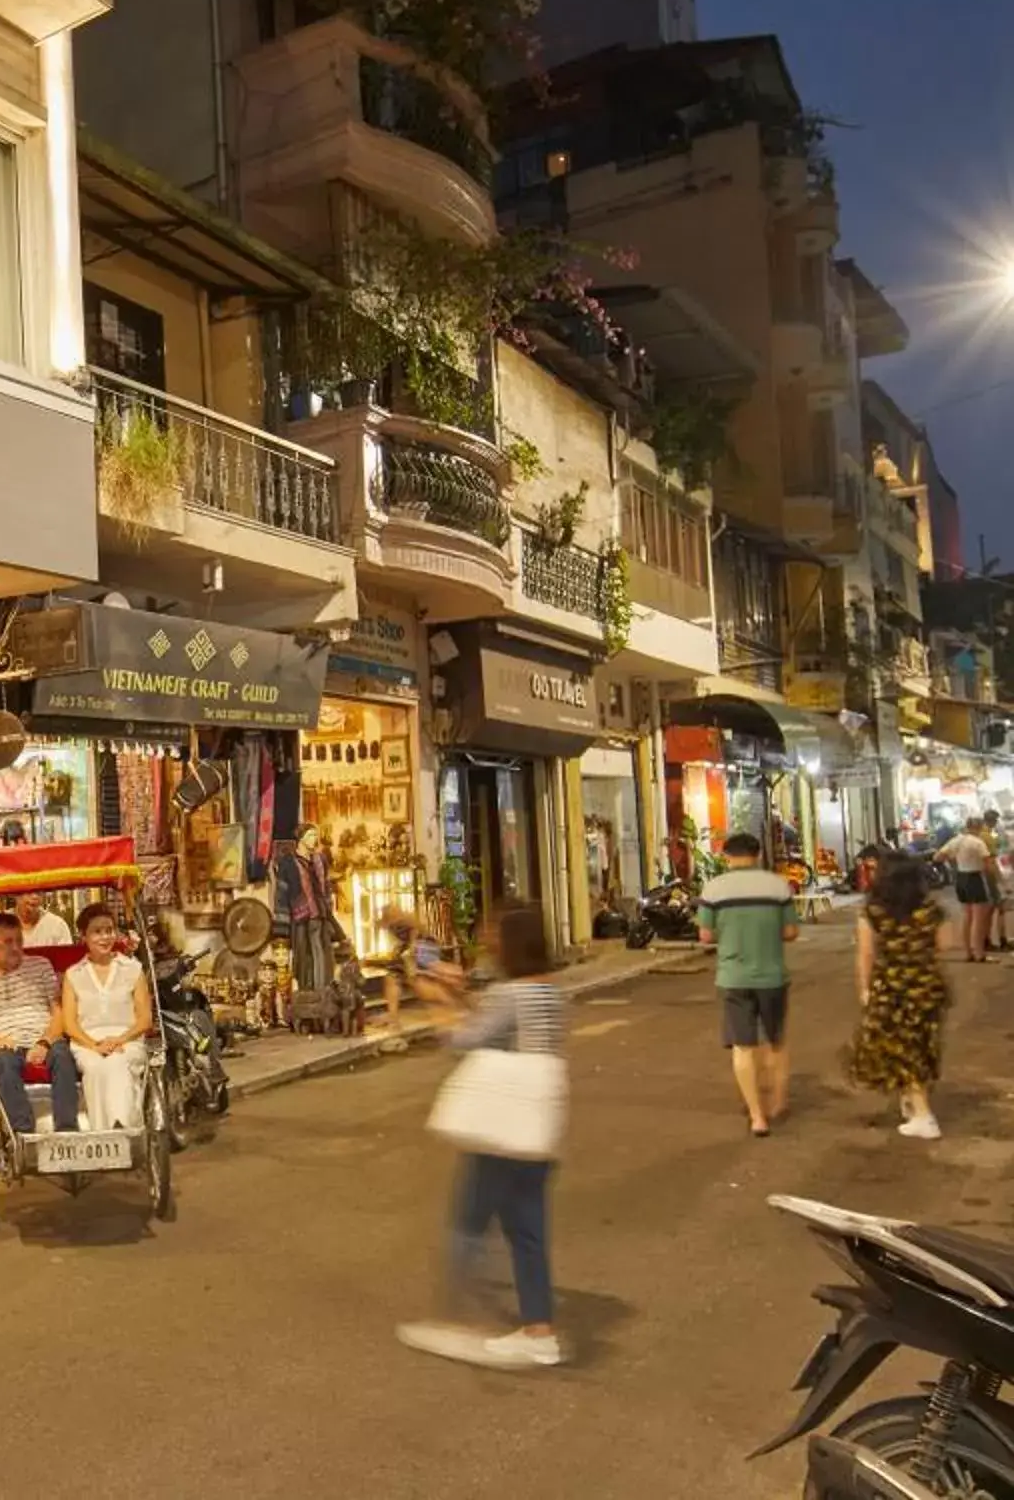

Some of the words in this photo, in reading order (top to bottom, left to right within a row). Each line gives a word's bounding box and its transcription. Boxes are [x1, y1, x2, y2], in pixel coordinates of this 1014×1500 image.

[102, 668, 190, 698] VIETNAMESE
[191, 678, 232, 701] CRAFT
[241, 683, 280, 705] GUILD
